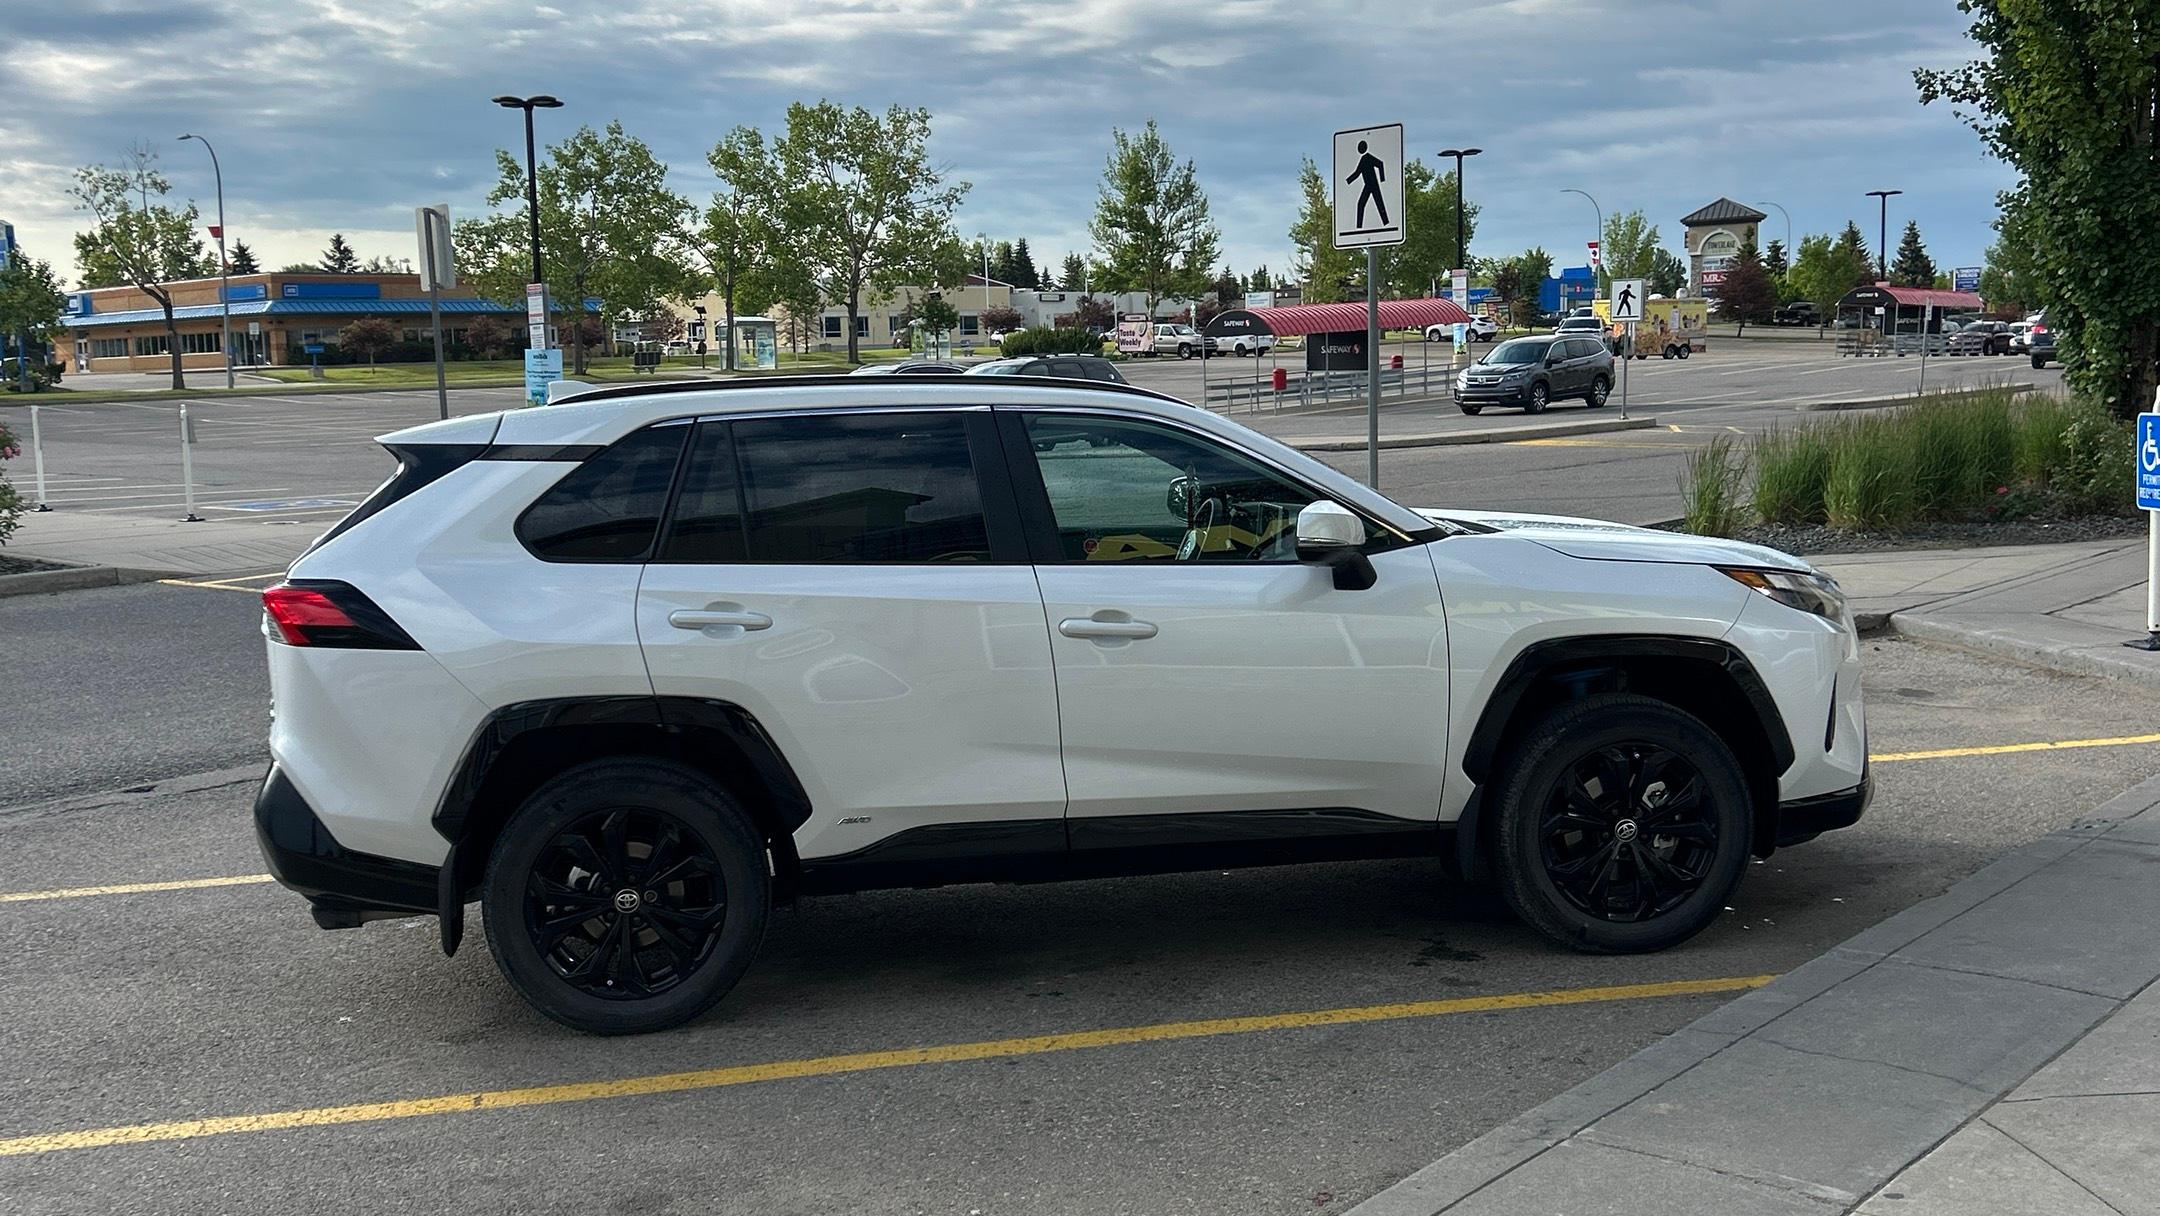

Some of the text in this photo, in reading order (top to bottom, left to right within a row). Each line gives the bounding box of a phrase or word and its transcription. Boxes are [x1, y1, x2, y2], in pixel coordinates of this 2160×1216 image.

[1120, 339, 1141, 348] Weekly
[1320, 345, 1351, 354] SAFEWAY
[837, 815, 871, 825] AWD
